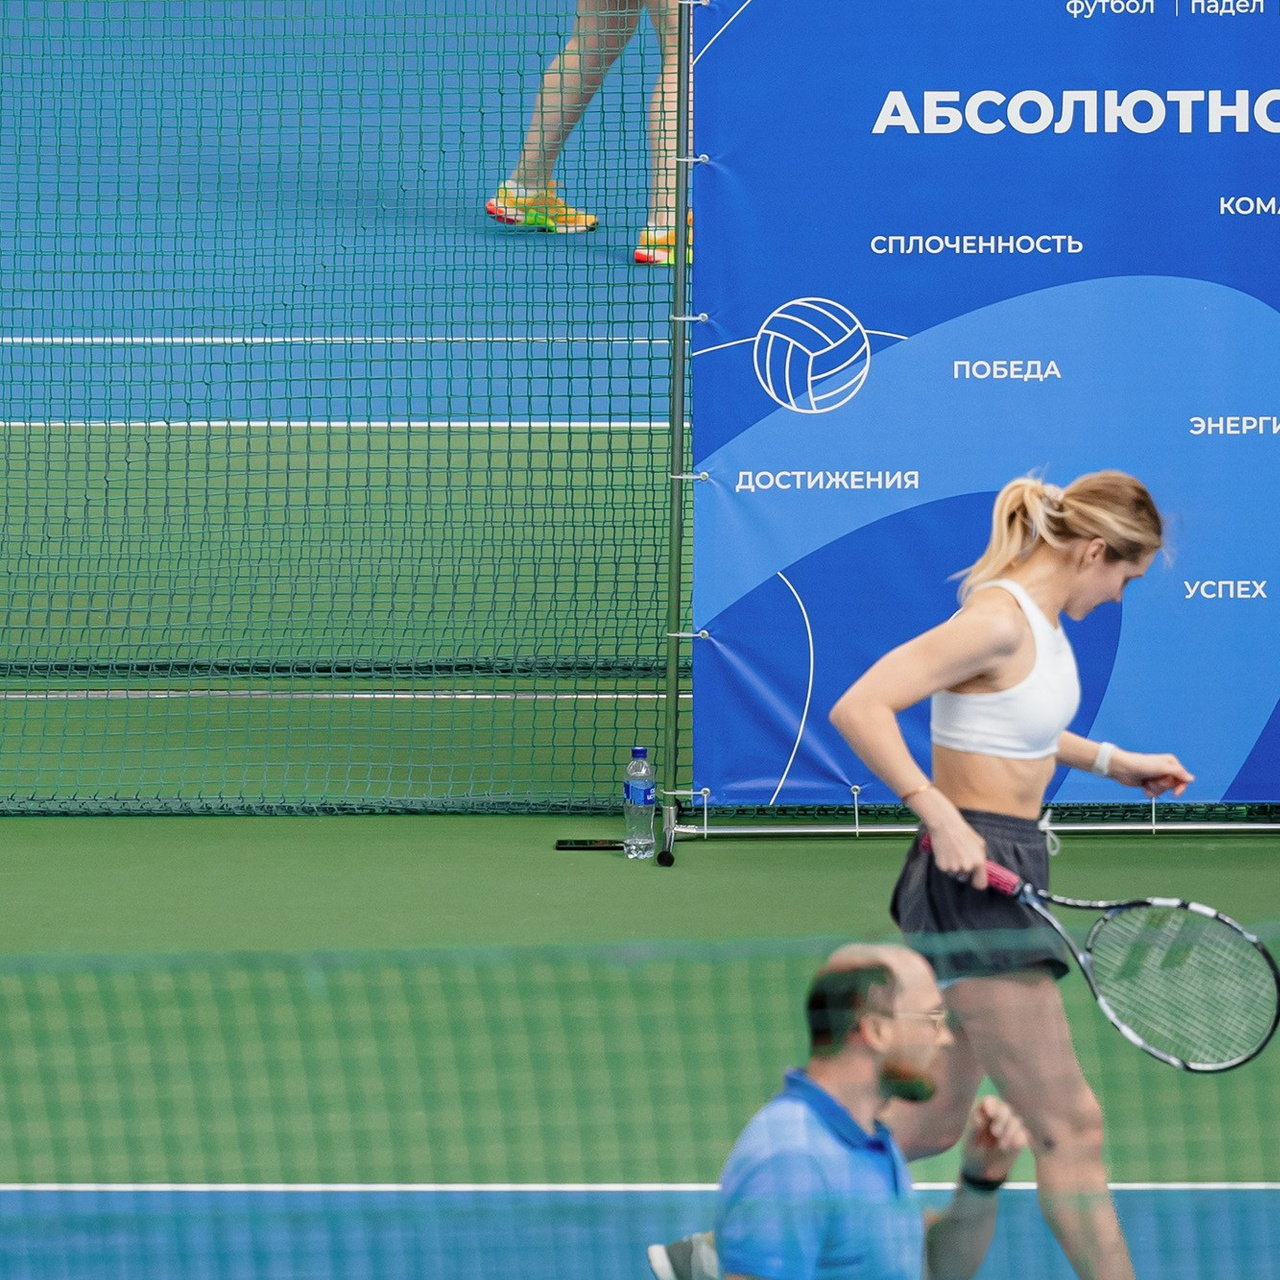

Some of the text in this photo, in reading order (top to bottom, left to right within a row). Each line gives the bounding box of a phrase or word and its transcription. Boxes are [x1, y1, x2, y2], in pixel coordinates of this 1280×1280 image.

[870, 234, 1084, 255] СПЛОЧЕННОСТЬ
[953, 360, 1062, 382] ПОБЕДА
[735, 470, 920, 493] ДОСТИЖЕНИЯ
[1183, 580, 1268, 600] УСПЕХ
